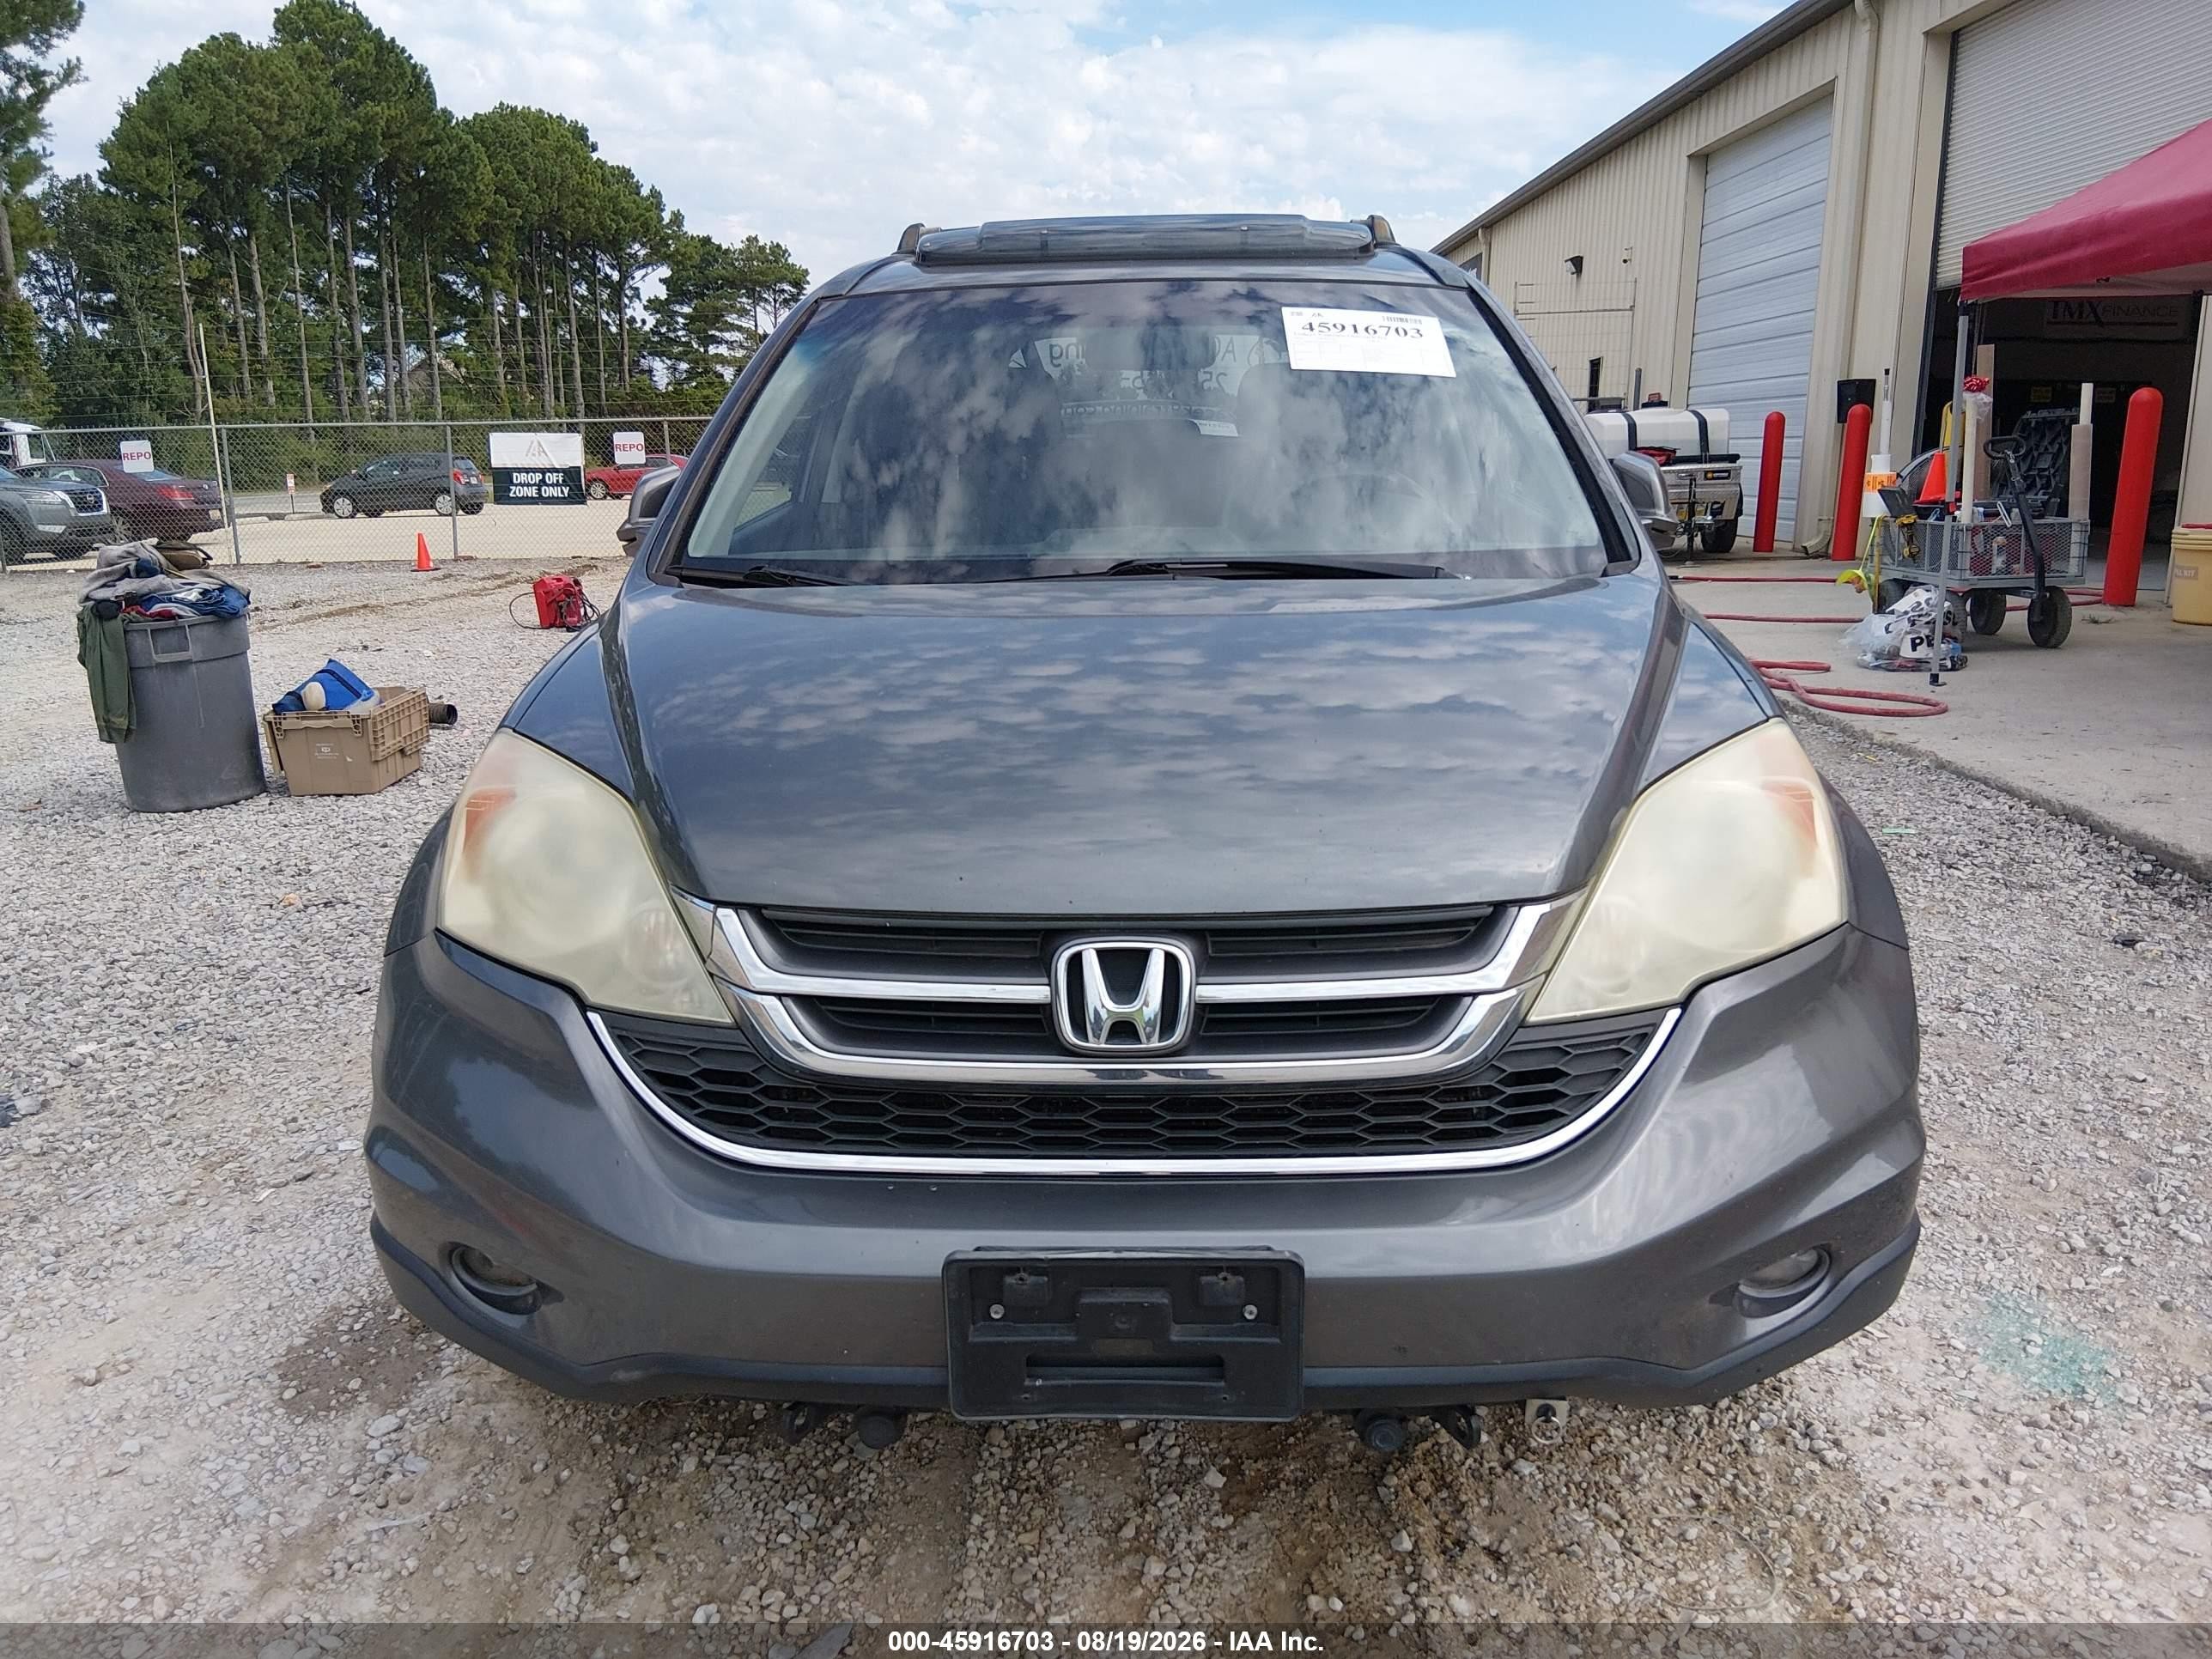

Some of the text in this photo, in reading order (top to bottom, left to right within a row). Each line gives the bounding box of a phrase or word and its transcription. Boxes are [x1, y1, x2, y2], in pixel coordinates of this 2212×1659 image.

[2047, 301, 2179, 326] TMX FINANCE
[1302, 321, 1424, 339] 45916703
[615, 443, 644, 452] REPO
[122, 451, 152, 461] REPO
[513, 472, 564, 484] DROP OFF
[509, 486, 569, 497] ZONE ONLY
